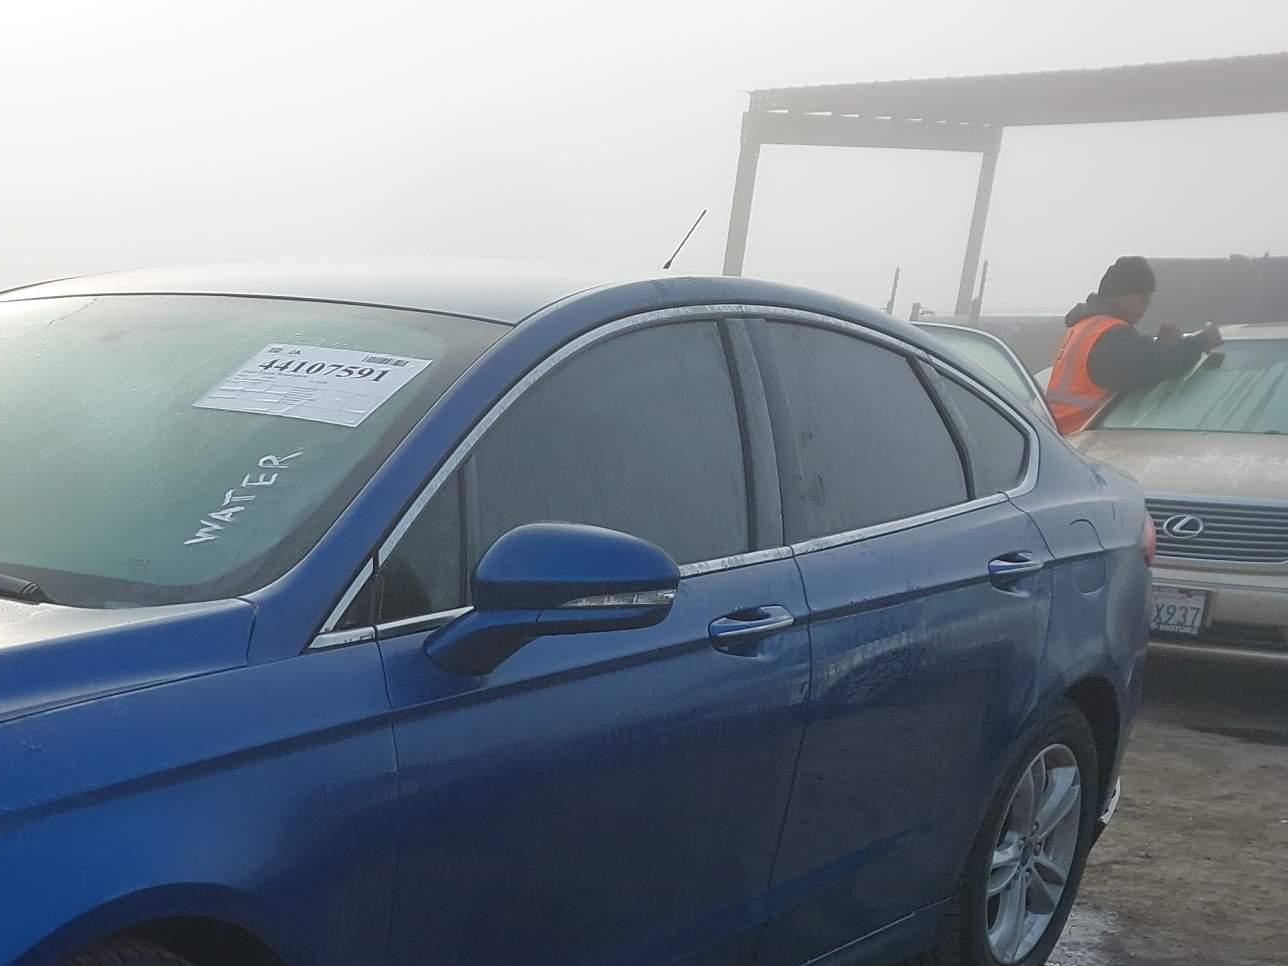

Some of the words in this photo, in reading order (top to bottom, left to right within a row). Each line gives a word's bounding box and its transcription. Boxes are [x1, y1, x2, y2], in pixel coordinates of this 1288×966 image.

[258, 358, 391, 382] 44107591
[184, 447, 304, 544] WATER
[1153, 604, 1200, 625] X937
